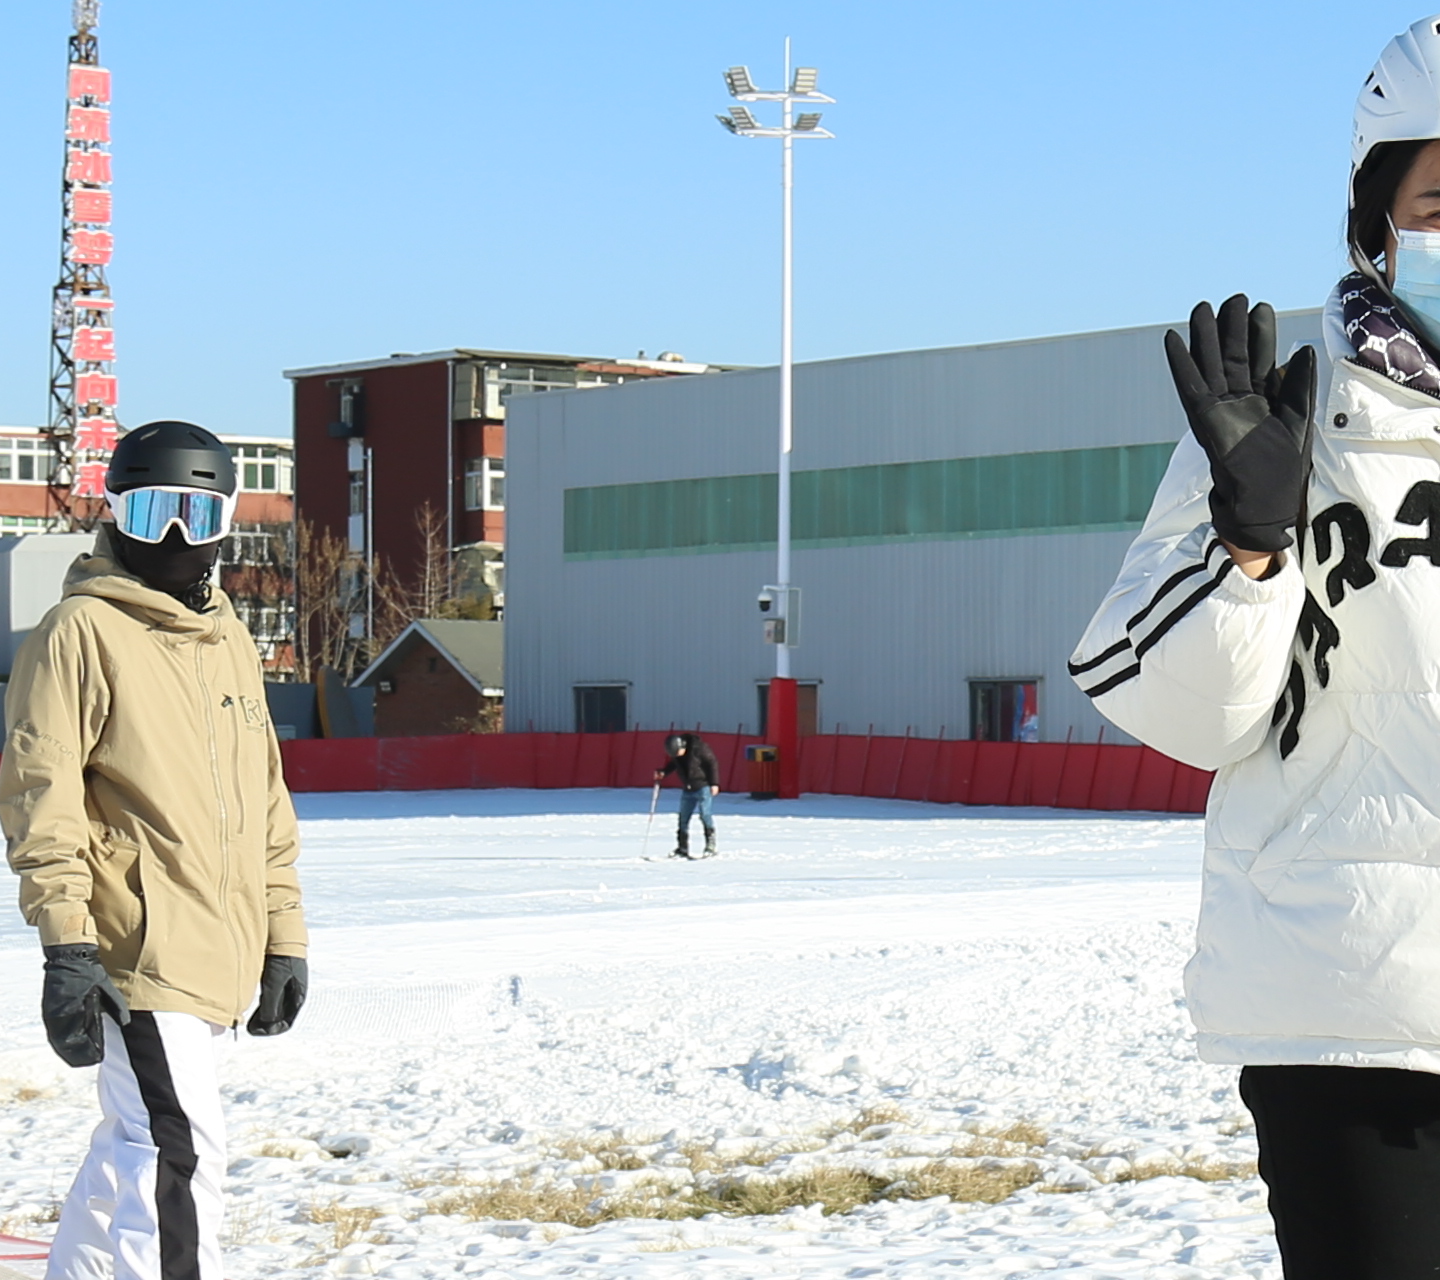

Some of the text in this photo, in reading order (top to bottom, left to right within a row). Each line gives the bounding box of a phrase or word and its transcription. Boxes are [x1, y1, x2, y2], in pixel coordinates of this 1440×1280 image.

[72, 297, 118, 499] 一起向未来
